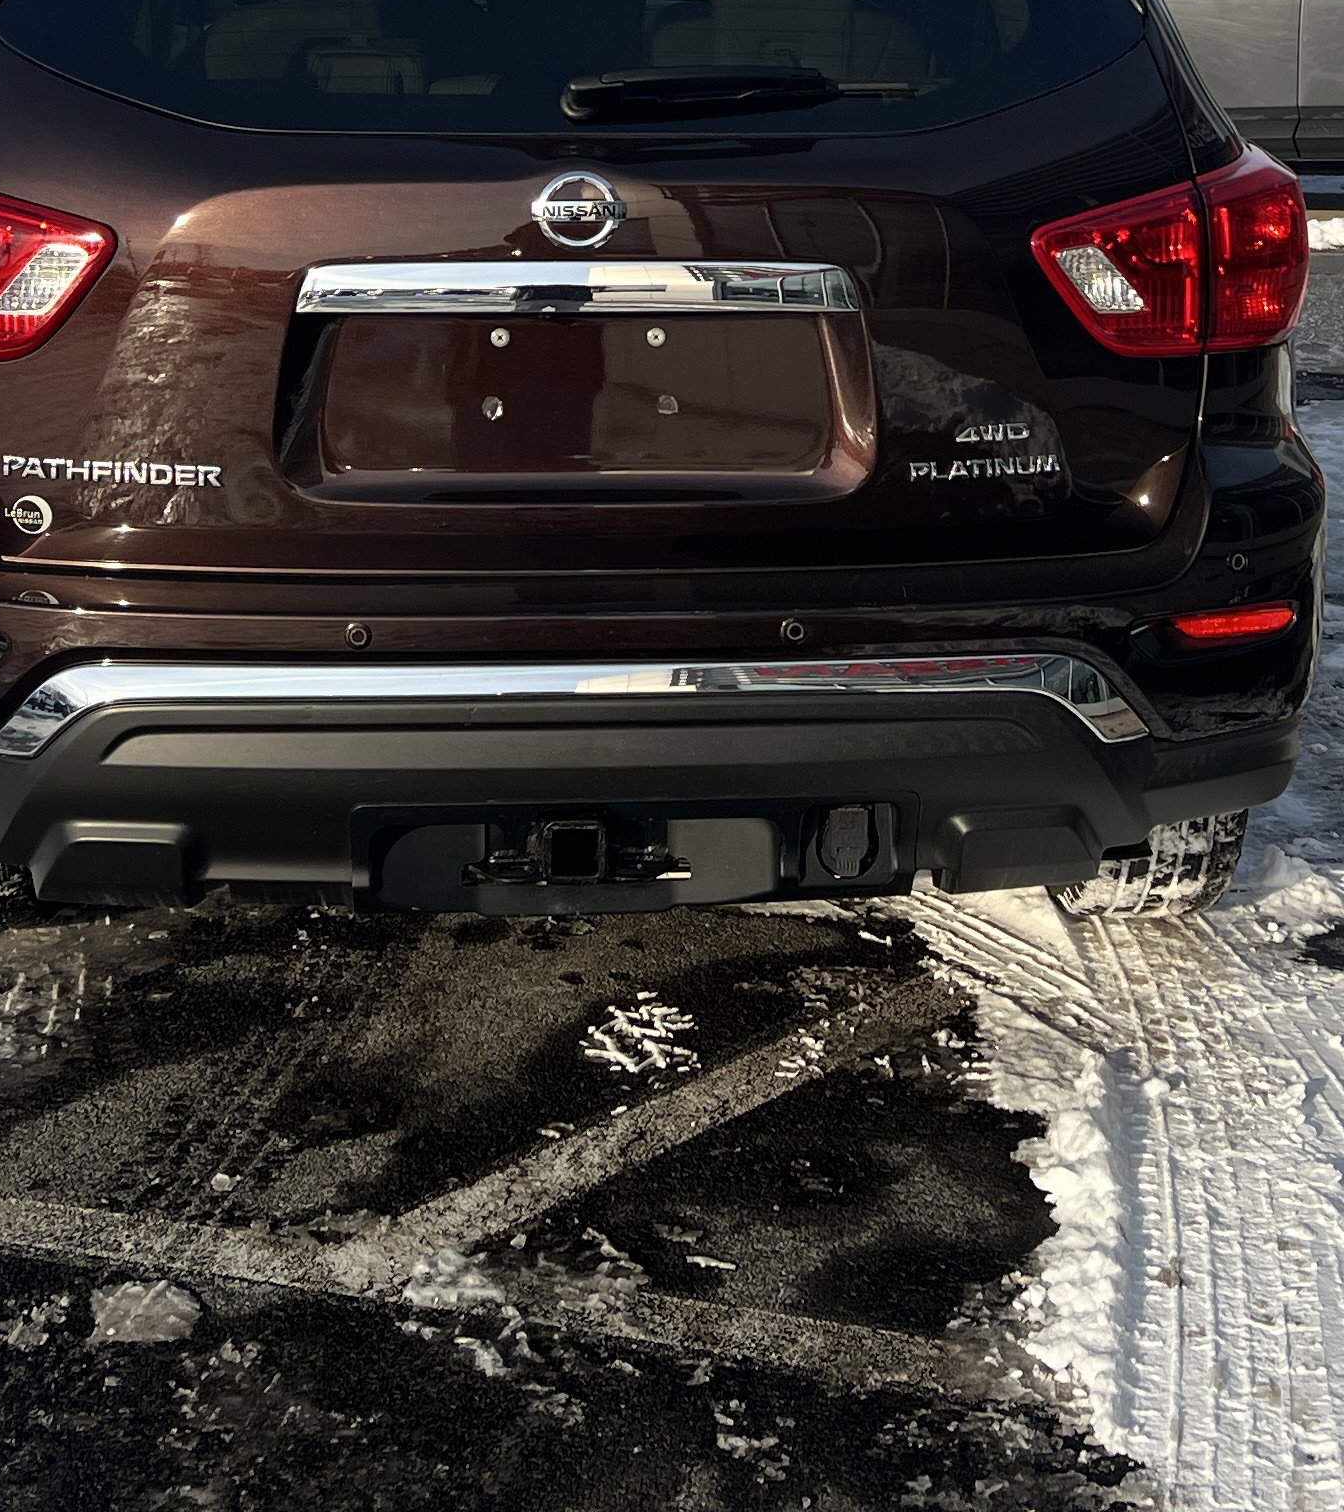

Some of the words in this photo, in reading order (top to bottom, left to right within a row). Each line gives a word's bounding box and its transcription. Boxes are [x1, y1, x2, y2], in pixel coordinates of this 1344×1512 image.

[543, 205, 616, 217] NISSAN
[956, 423, 1029, 442] 4WD
[2, 455, 222, 487] PATHFINDER
[910, 455, 1060, 482] PLATINUM
[4, 507, 41, 519] LeBrun
